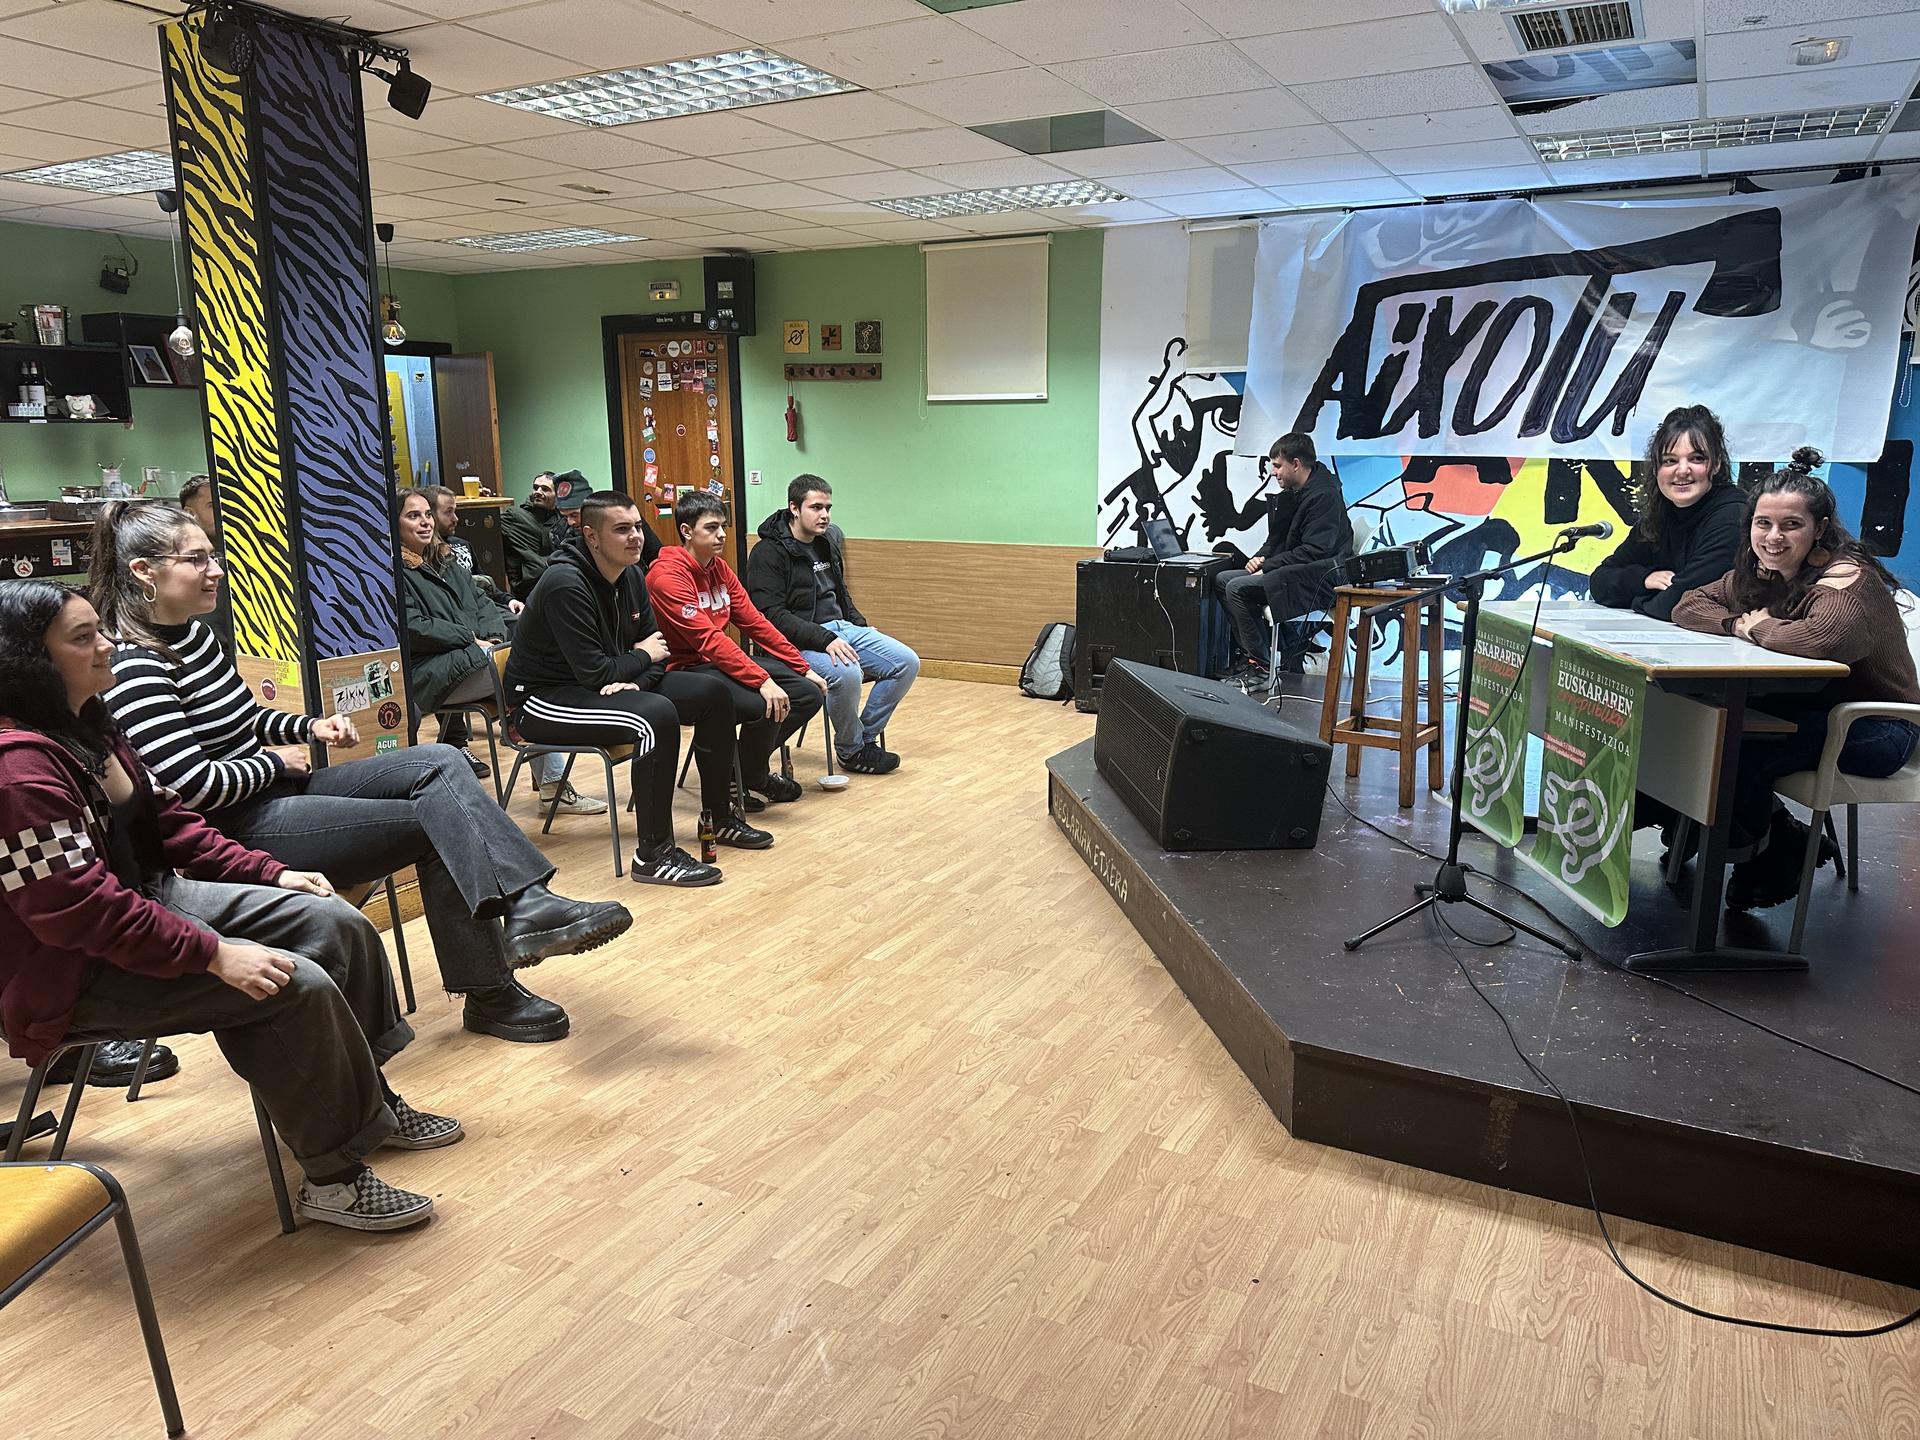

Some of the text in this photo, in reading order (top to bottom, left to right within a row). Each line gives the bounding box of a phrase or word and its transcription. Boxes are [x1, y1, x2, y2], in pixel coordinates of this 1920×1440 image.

[1474, 638, 1524, 668] USKARAREN
[1471, 673, 1523, 703] ANIFESTAZIOA
[1557, 670, 1634, 716] EUSKARAREN
[1560, 659, 1634, 697] EUSKARAZ BIZITZEKO
[376, 739, 398, 750] AGUR
[1555, 710, 1631, 757] MANIFESTAZIOA
